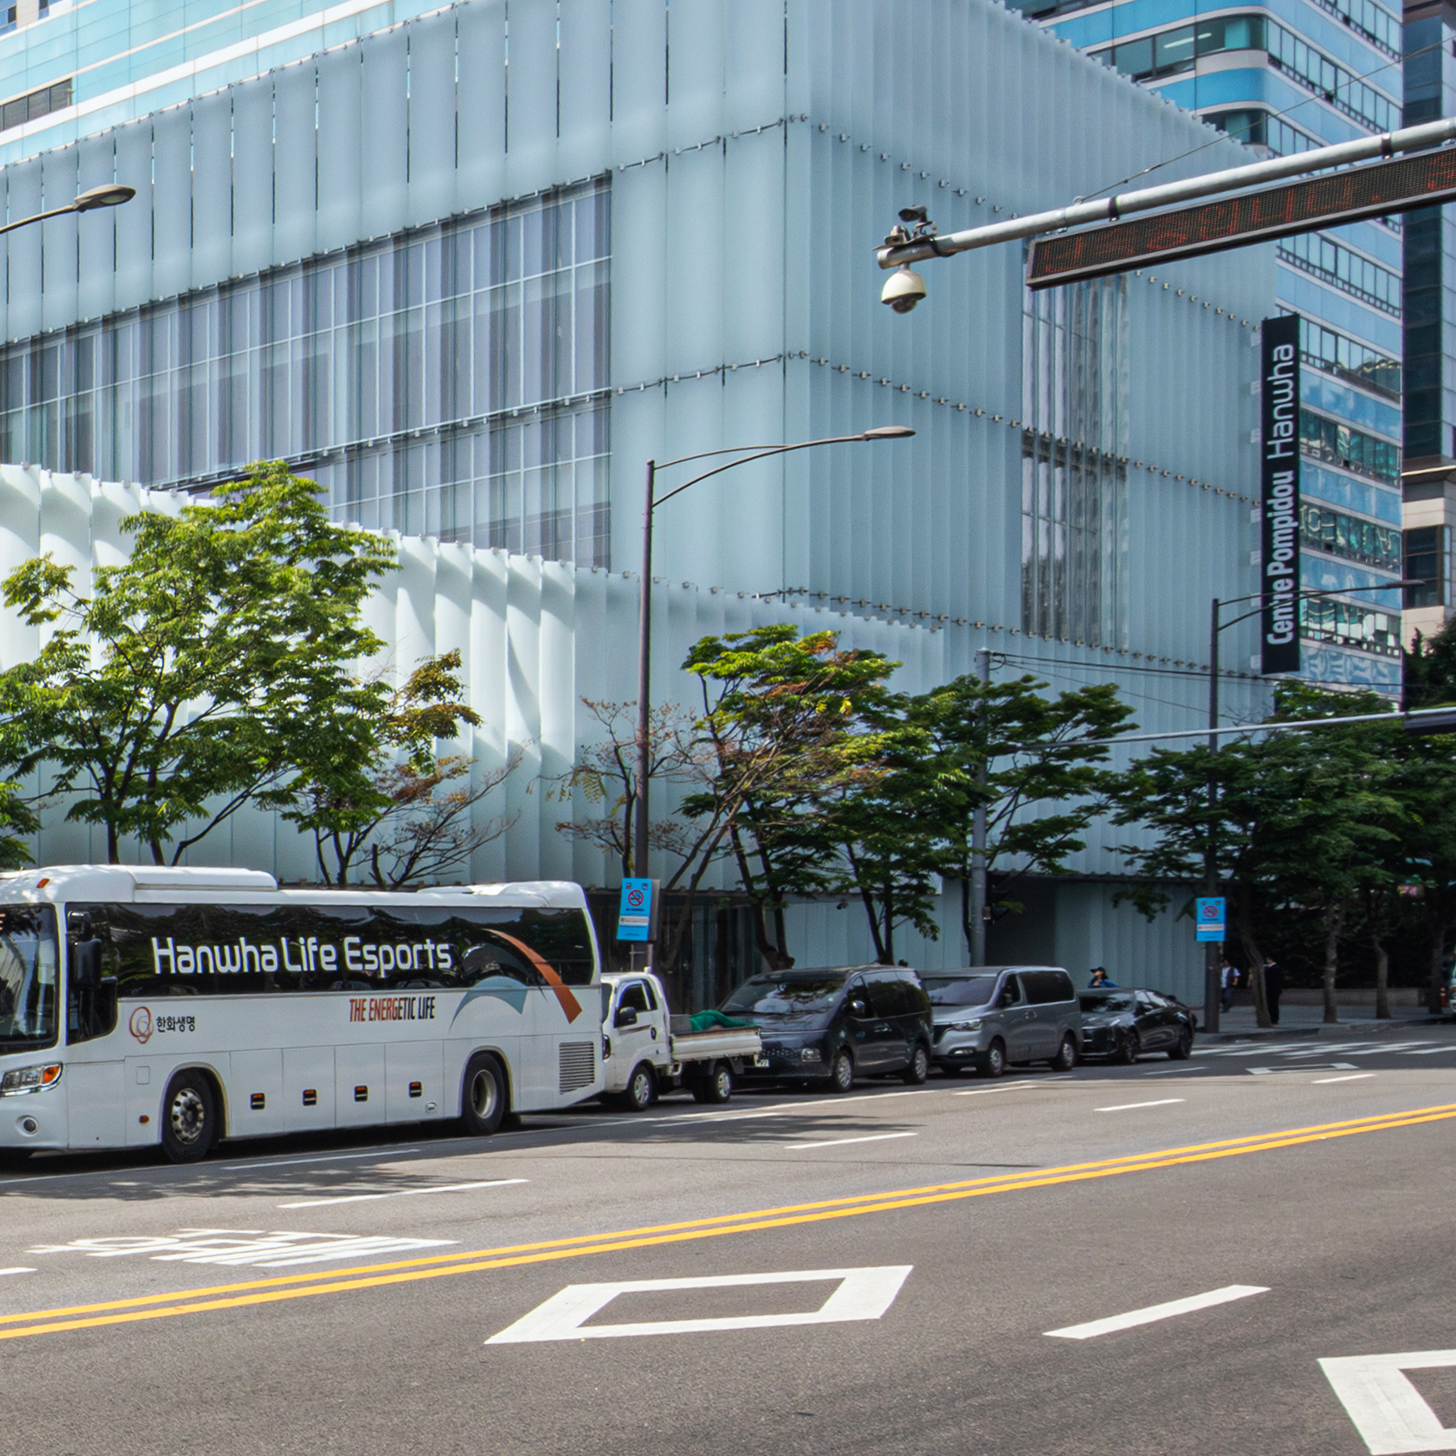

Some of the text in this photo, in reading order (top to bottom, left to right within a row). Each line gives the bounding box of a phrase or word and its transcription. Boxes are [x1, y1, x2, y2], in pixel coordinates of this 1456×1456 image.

[1266, 343, 1299, 645] Centre Pompidou Hanwha
[150, 936, 453, 979] Hanwha Life Esports
[155, 1015, 196, 1033] 한화생명
[348, 996, 436, 1022] THE ENERGETIC LIFE
